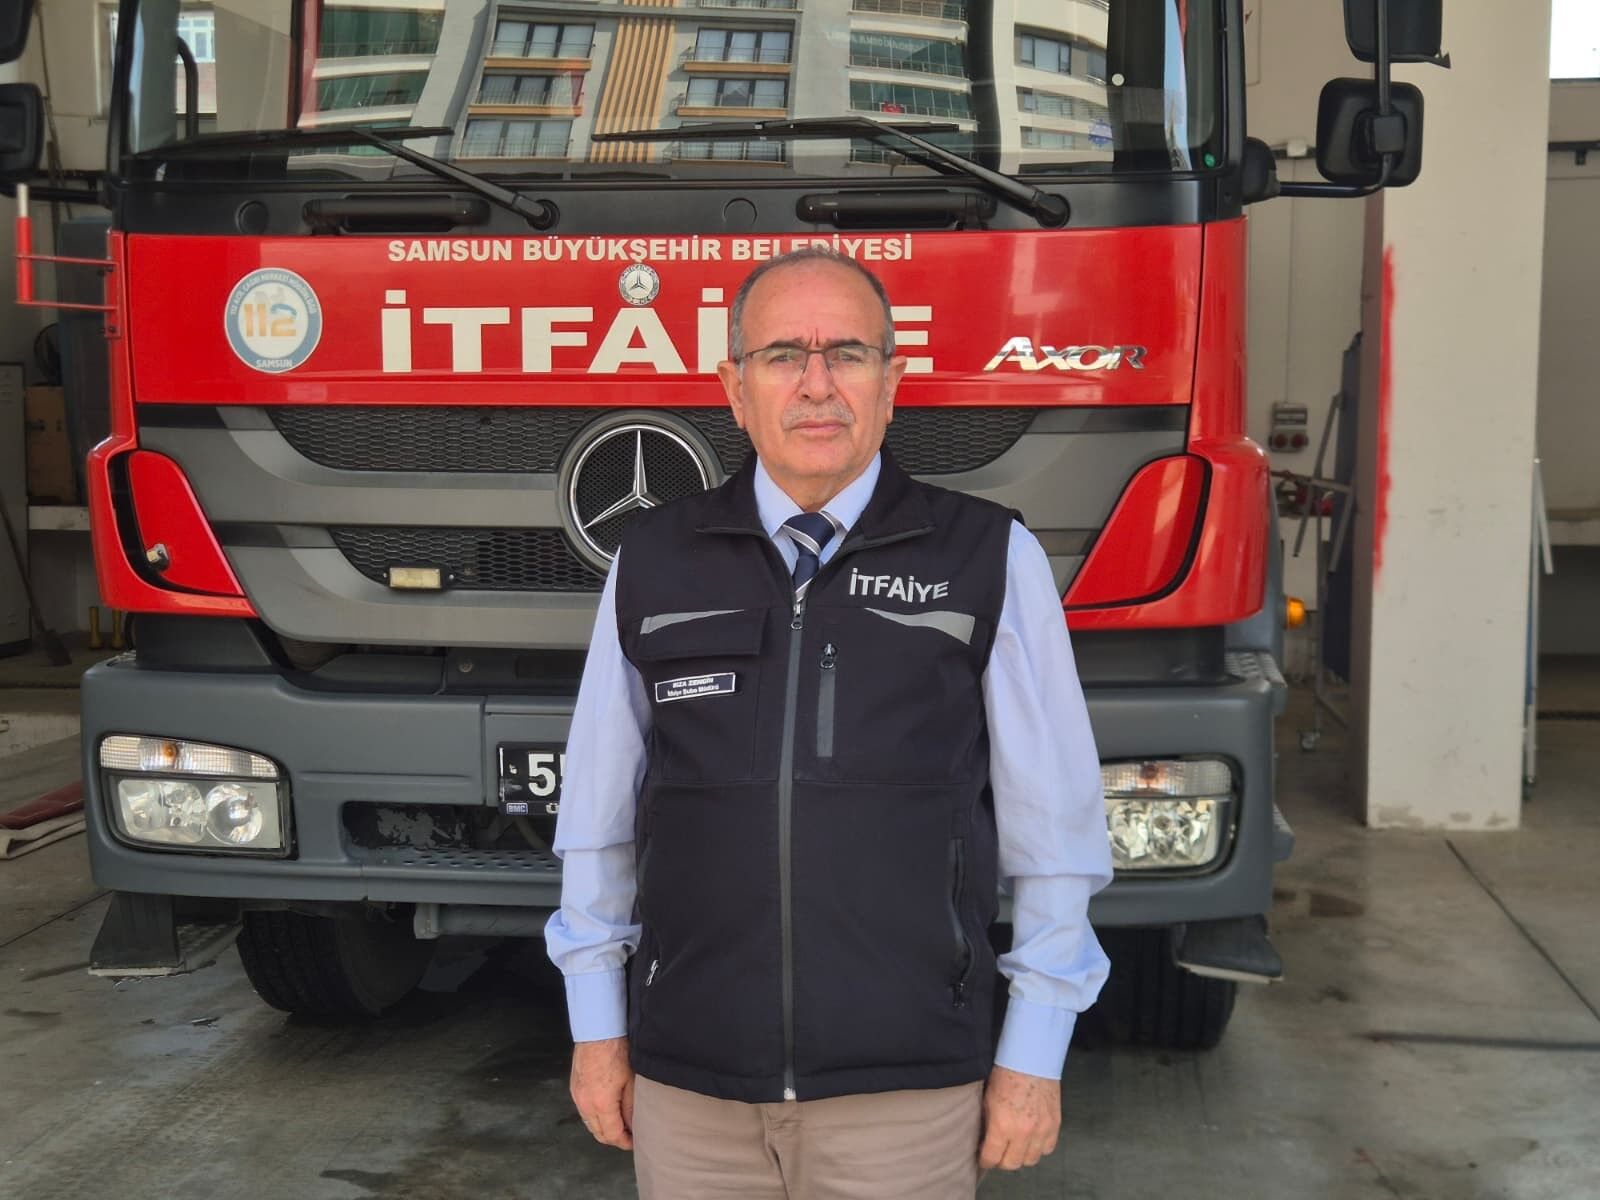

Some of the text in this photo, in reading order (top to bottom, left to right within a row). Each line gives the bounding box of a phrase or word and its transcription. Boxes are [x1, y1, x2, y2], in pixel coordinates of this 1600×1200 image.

[388, 239, 512, 262] SAMSUN
[523, 235, 721, 263] BÜYÜKŞEHİR
[243, 303, 297, 337] 112
[381, 288, 934, 374] İTFAİE
[255, 359, 293, 368] SAMSUN
[849, 567, 949, 603] İTFAİYE
[528, 753, 566, 796] 5
